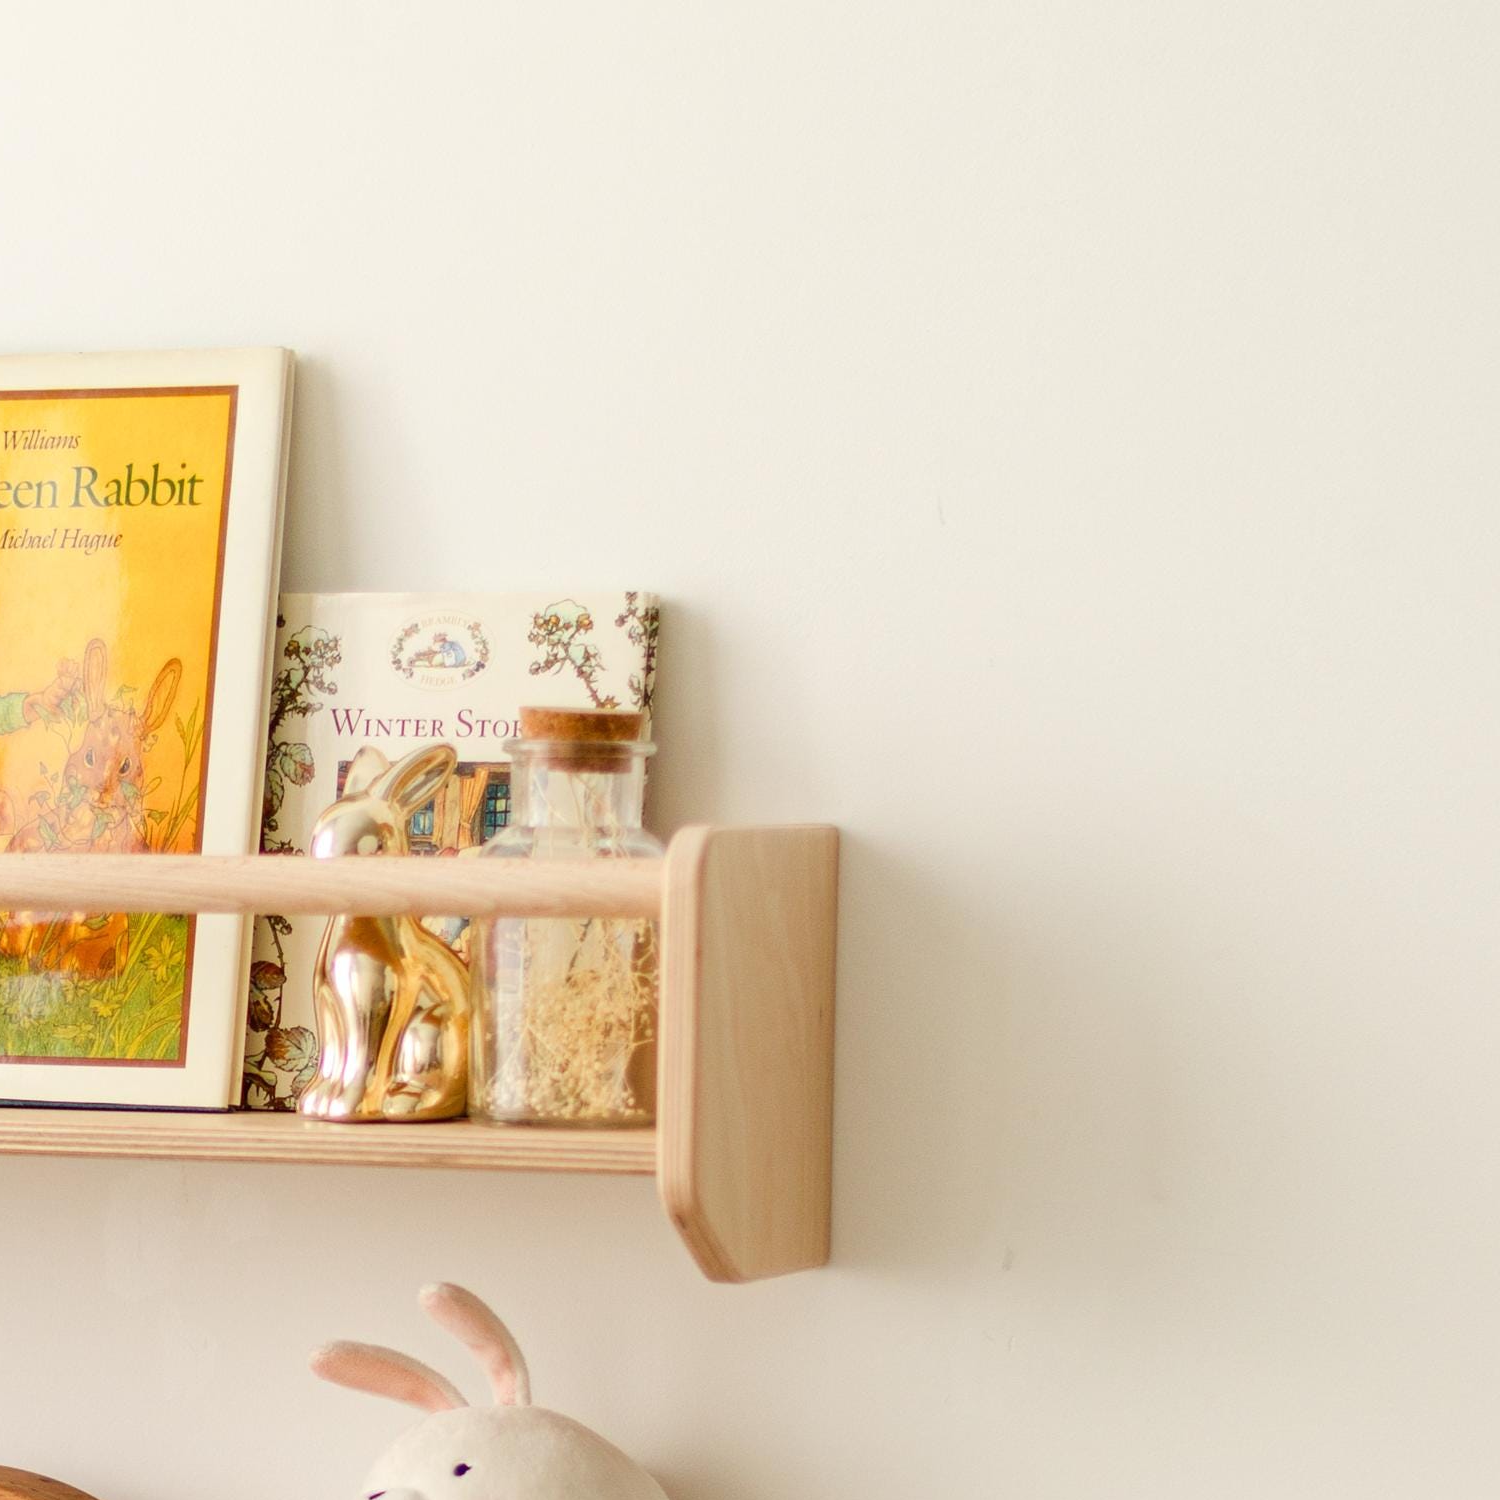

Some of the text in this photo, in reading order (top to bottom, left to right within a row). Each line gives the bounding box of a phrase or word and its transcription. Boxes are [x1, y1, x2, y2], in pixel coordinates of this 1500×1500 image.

[3, 429, 81, 451] Williams
[69, 462, 205, 509] Rabbit
[59, 528, 123, 556] Hague
[330, 707, 523, 738] WINTER STOR
